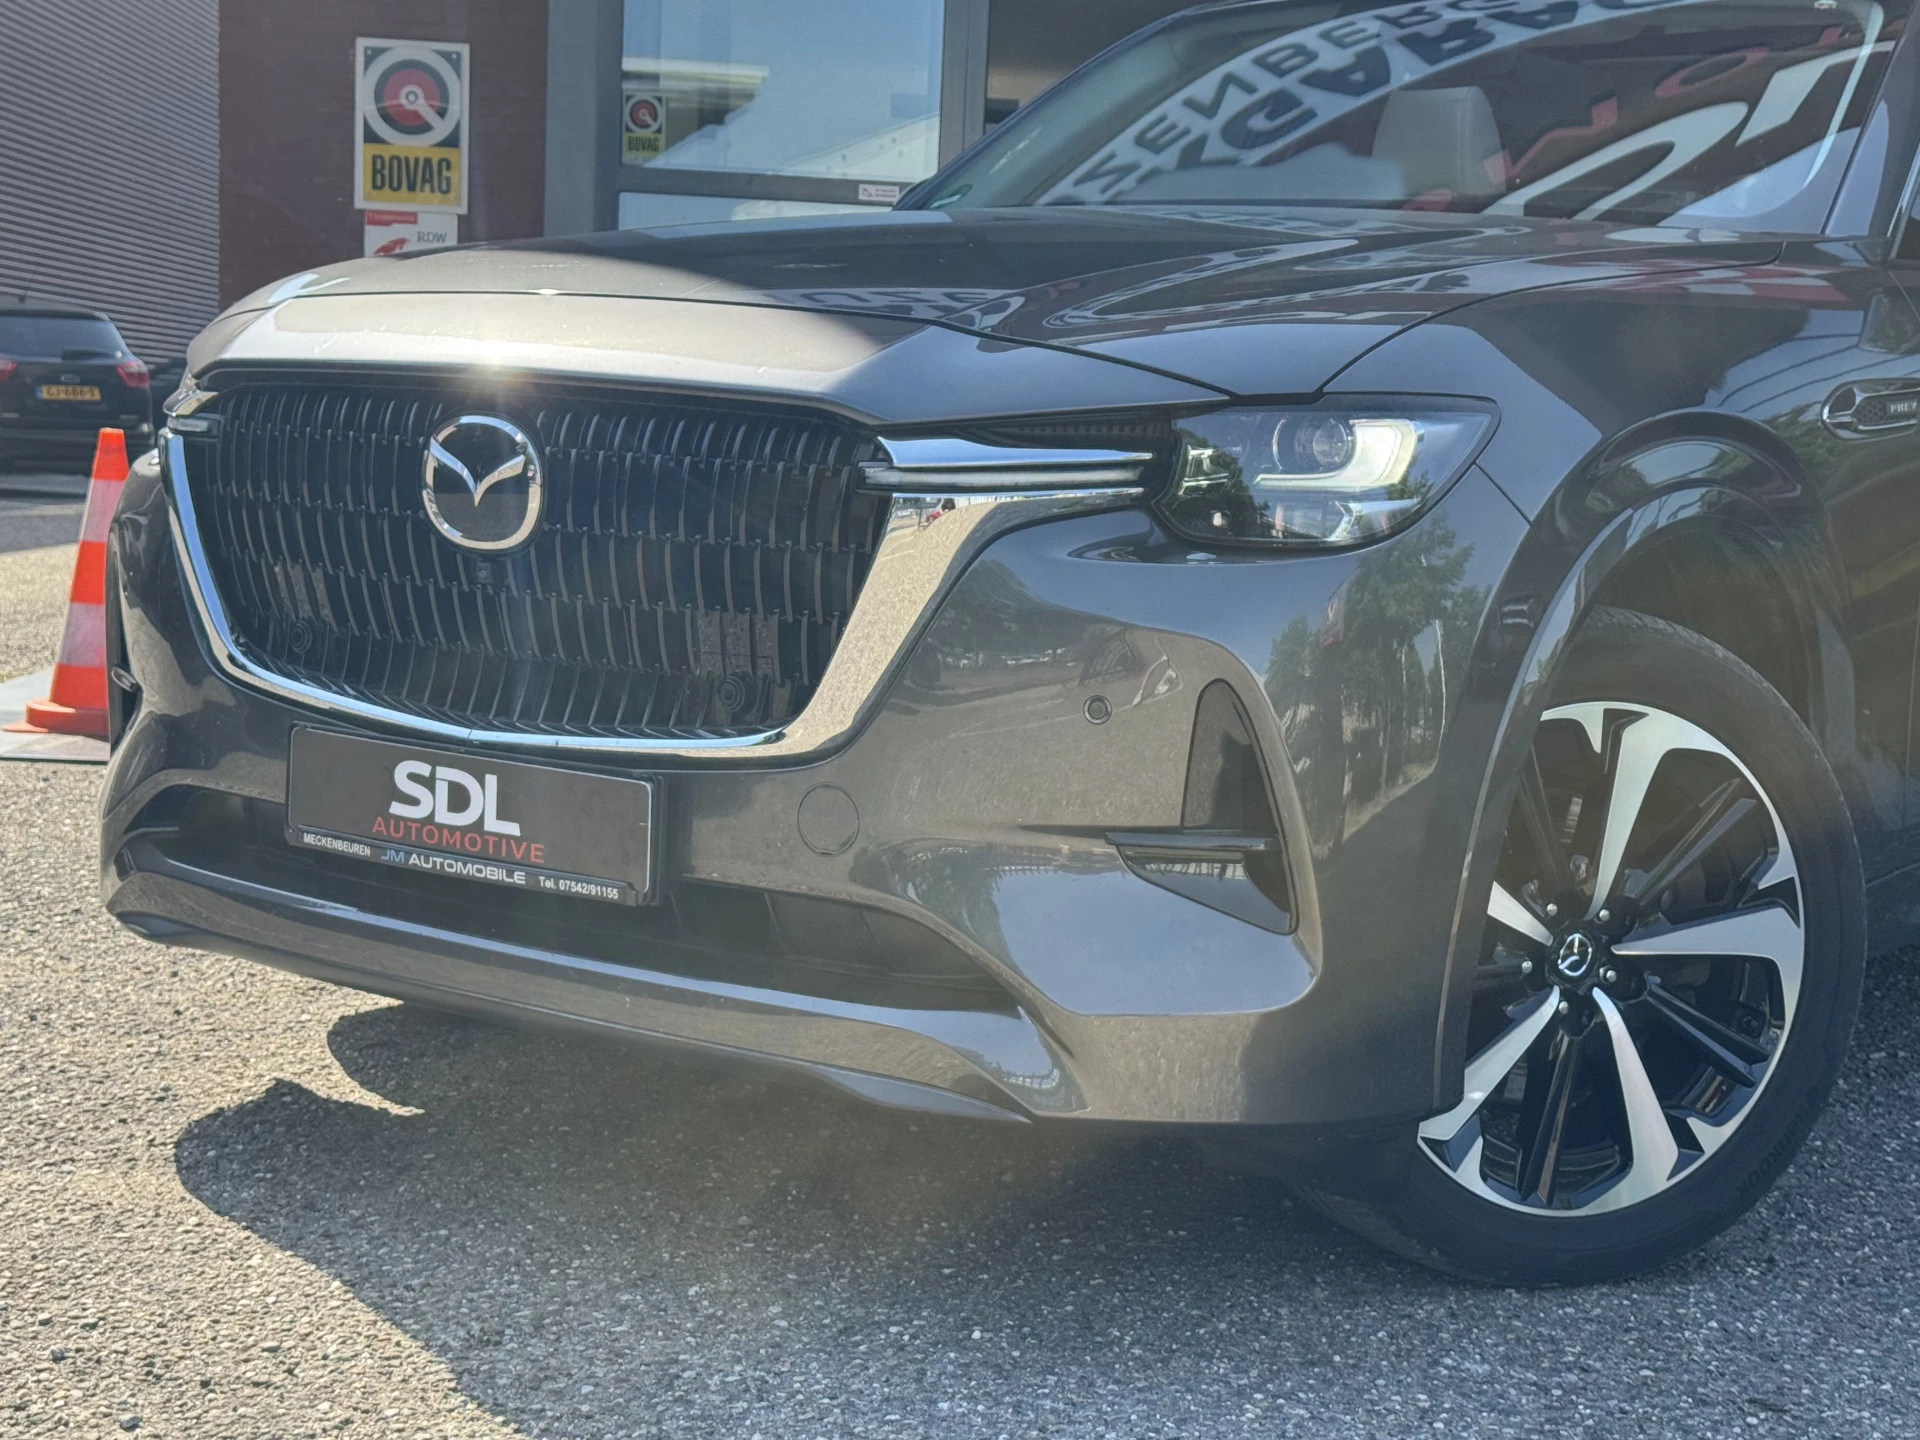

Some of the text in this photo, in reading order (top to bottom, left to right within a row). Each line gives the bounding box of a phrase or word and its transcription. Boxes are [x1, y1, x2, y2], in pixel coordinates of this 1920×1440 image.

[627, 136, 660, 152] BOVAG
[371, 153, 453, 195] BOVAG
[416, 231, 447, 243] RDW
[389, 760, 521, 836] SDL
[372, 816, 545, 864] AUTOMOTIVE
[303, 833, 619, 900] MECKENBEUREN JM AUTOMOBILE Tel. 07542/91155
